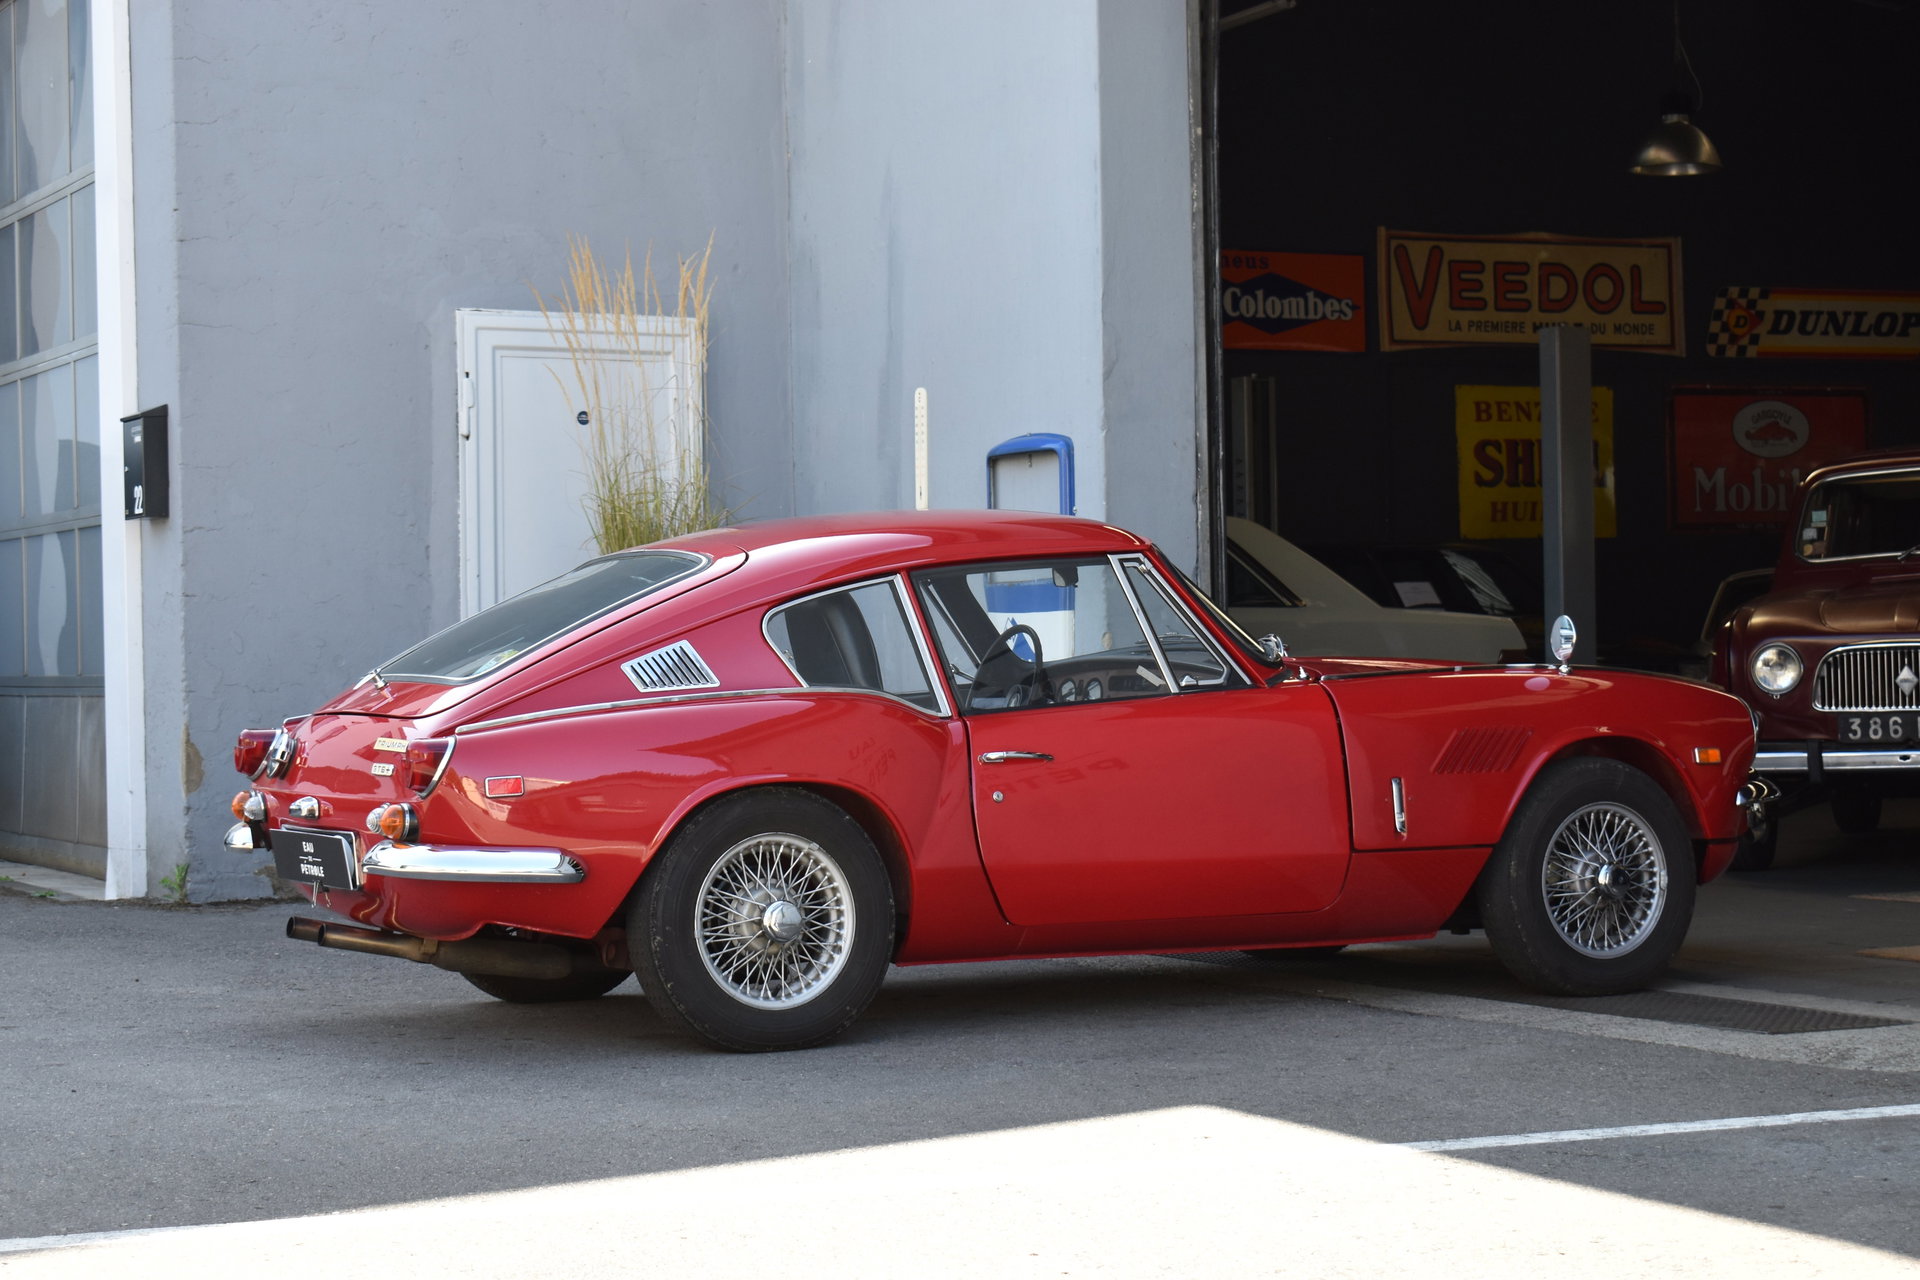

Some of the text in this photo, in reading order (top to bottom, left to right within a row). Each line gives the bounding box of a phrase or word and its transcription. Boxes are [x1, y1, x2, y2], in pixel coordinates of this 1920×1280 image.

[1394, 243, 1666, 331] VEEDOL
[1222, 287, 1353, 321] Colombes
[1447, 319, 1462, 333] LA
[1590, 322, 1606, 335] DU
[1613, 322, 1655, 335] MONDE
[1766, 309, 1920, 337] DUNLOP
[134, 484, 144, 515] 22
[1848, 715, 1903, 740] 386
[302, 841, 314, 853] EAU
[300, 860, 325, 877] PÉTROLE
